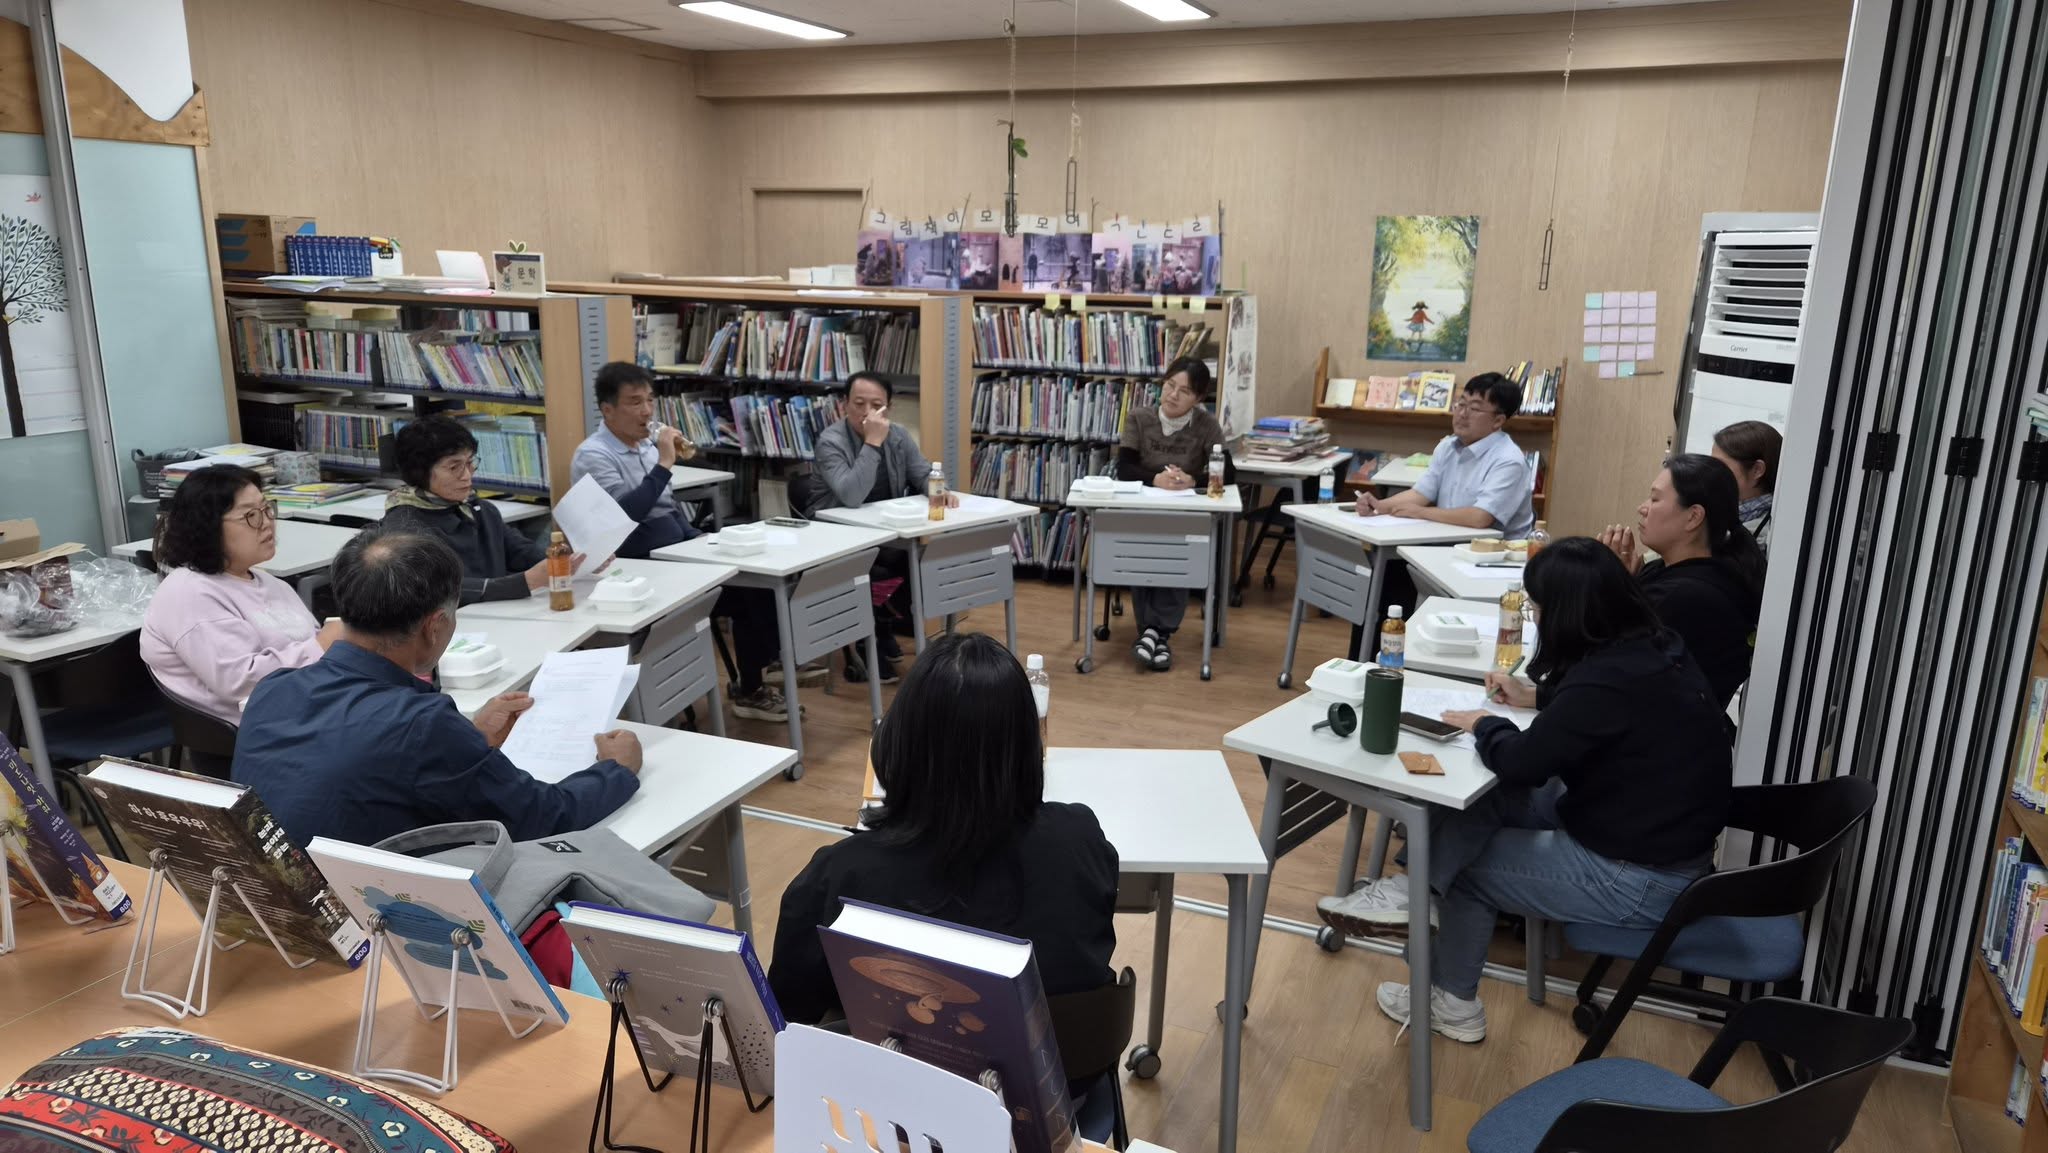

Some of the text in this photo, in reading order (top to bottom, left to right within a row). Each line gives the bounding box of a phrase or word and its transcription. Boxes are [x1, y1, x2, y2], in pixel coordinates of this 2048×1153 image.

[518, 267, 536, 280] 문학
[1730, 344, 1748, 353] Carrier
[9, 758, 37, 796] 미드나잇
[262, 827, 285, 854] 보이지
[119, 899, 131, 914] 800
[354, 946, 368, 961] 800
